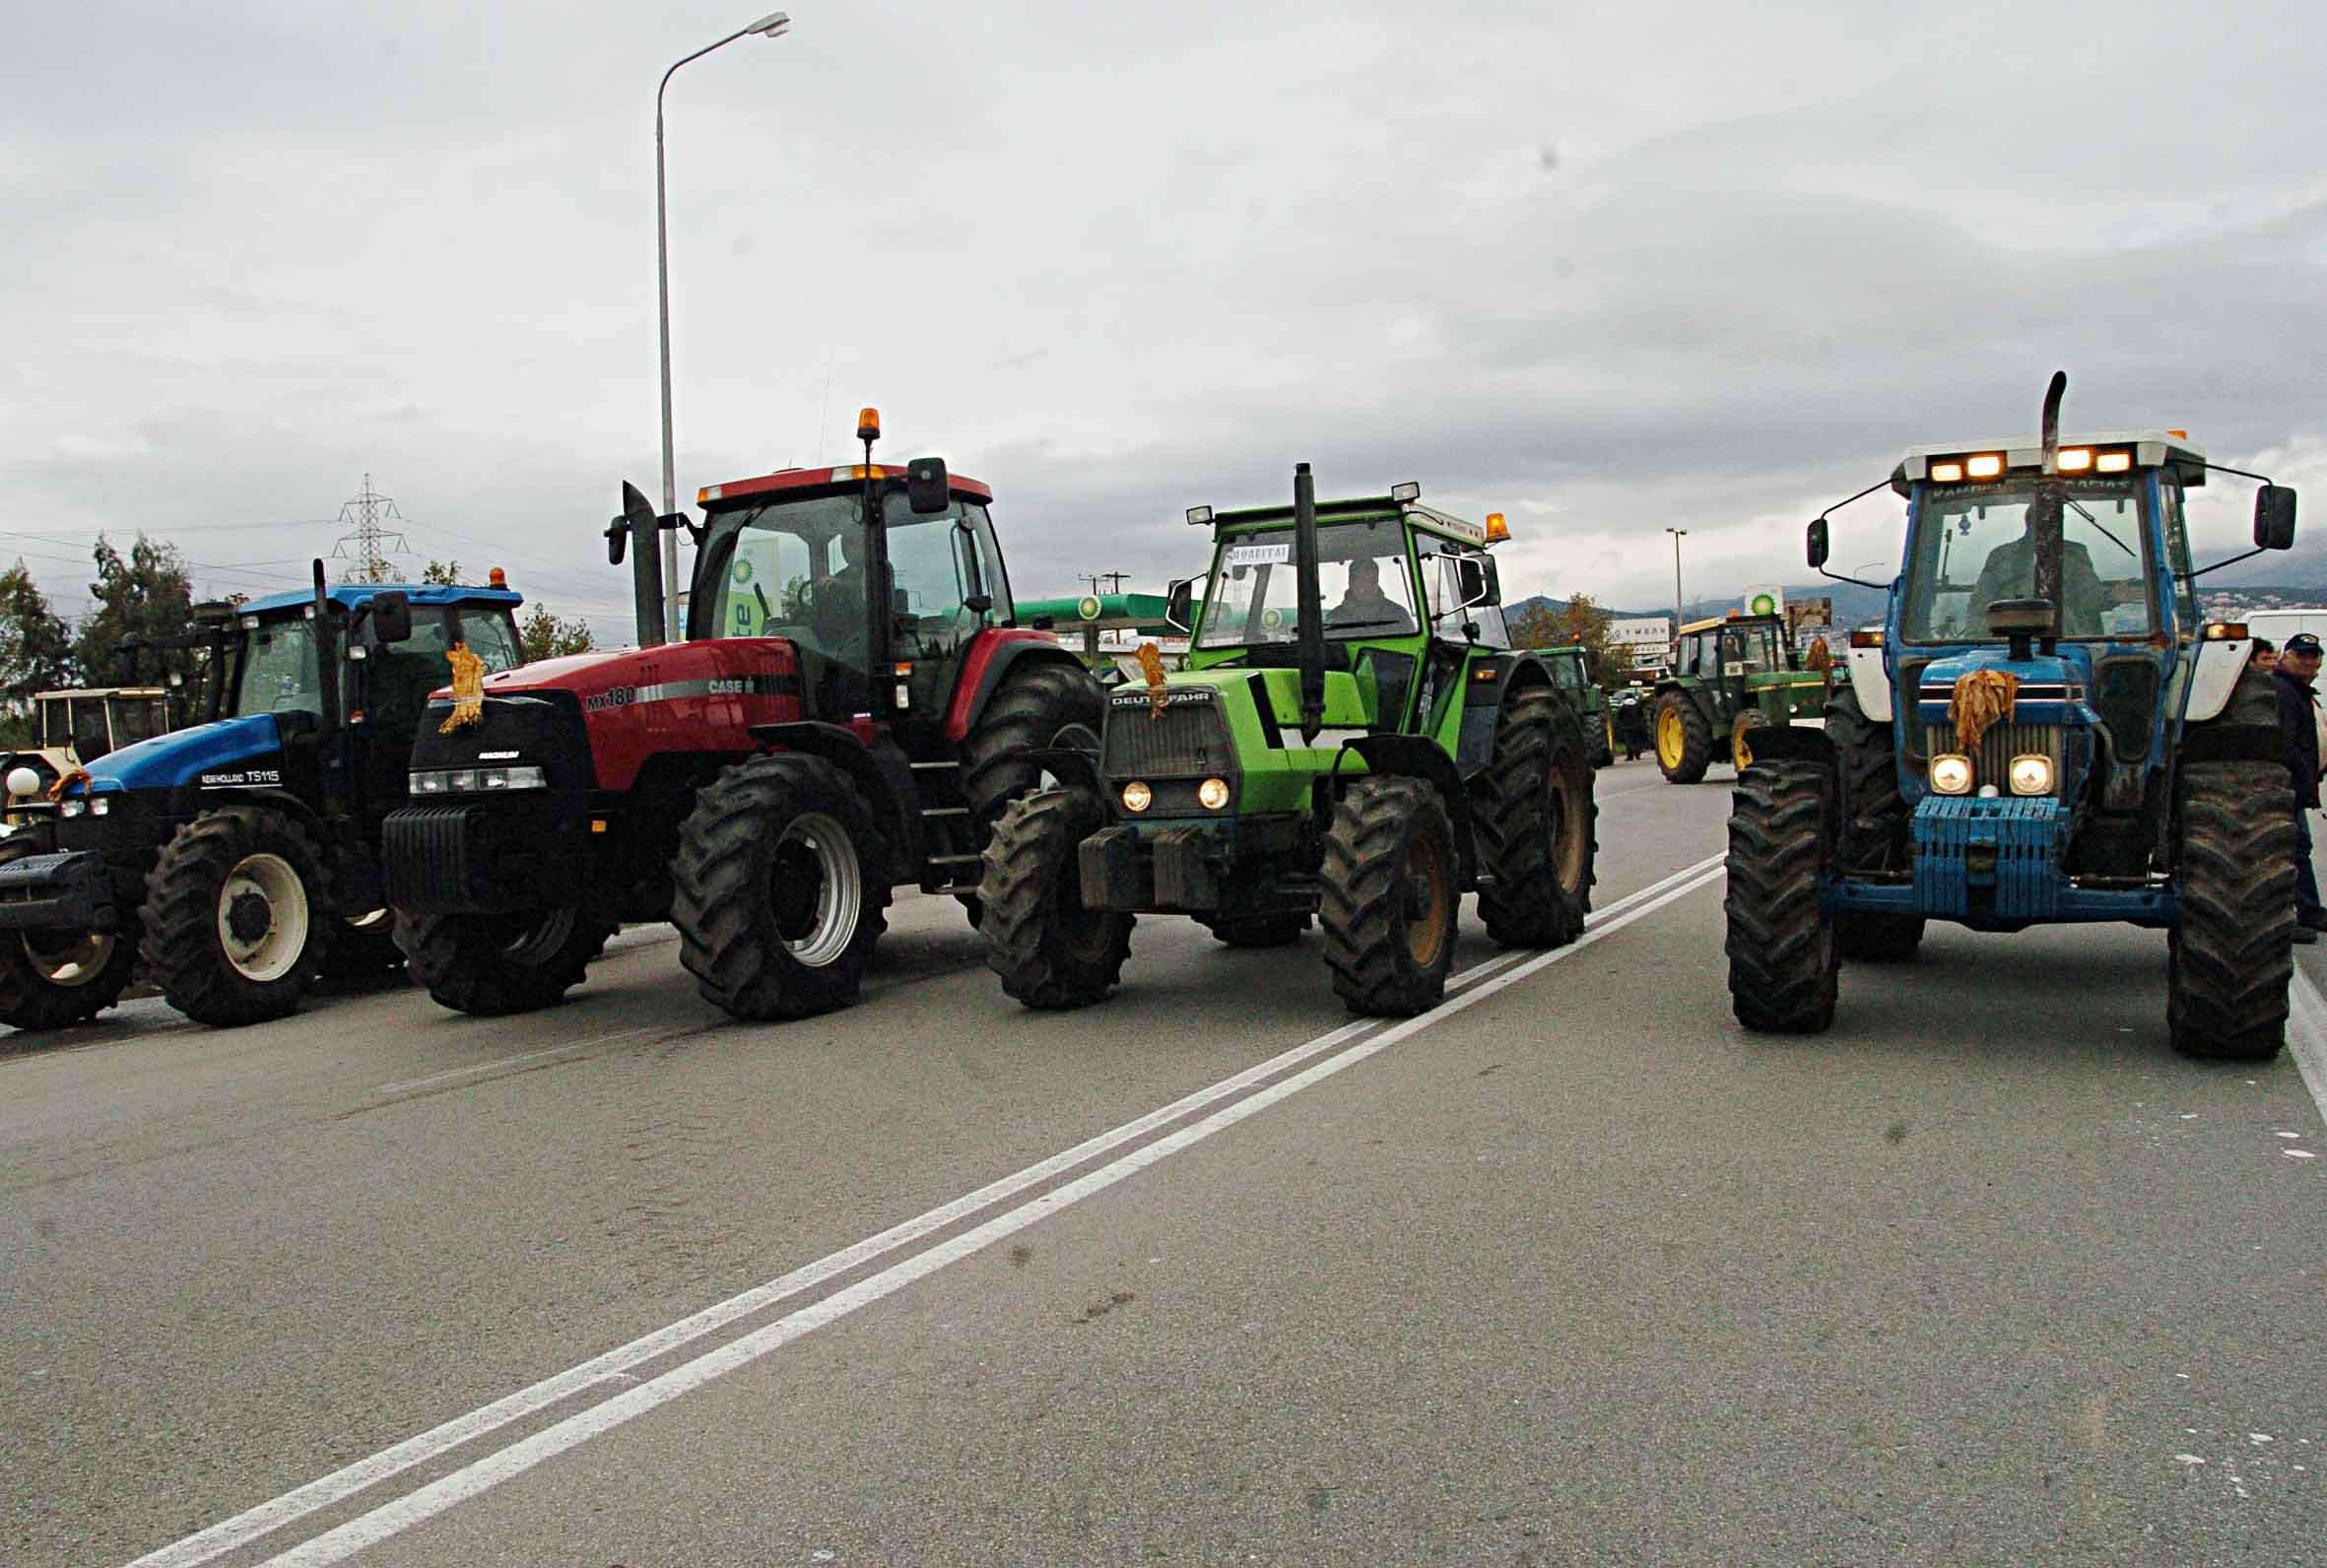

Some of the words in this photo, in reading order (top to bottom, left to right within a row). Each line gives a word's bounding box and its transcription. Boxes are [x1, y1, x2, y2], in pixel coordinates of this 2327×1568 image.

[708, 680, 742, 694] CASE
[586, 686, 635, 711] MX180
[1111, 694, 1152, 706] DEUT
[1167, 691, 1210, 703] FAHR
[246, 770, 280, 782] TS115
